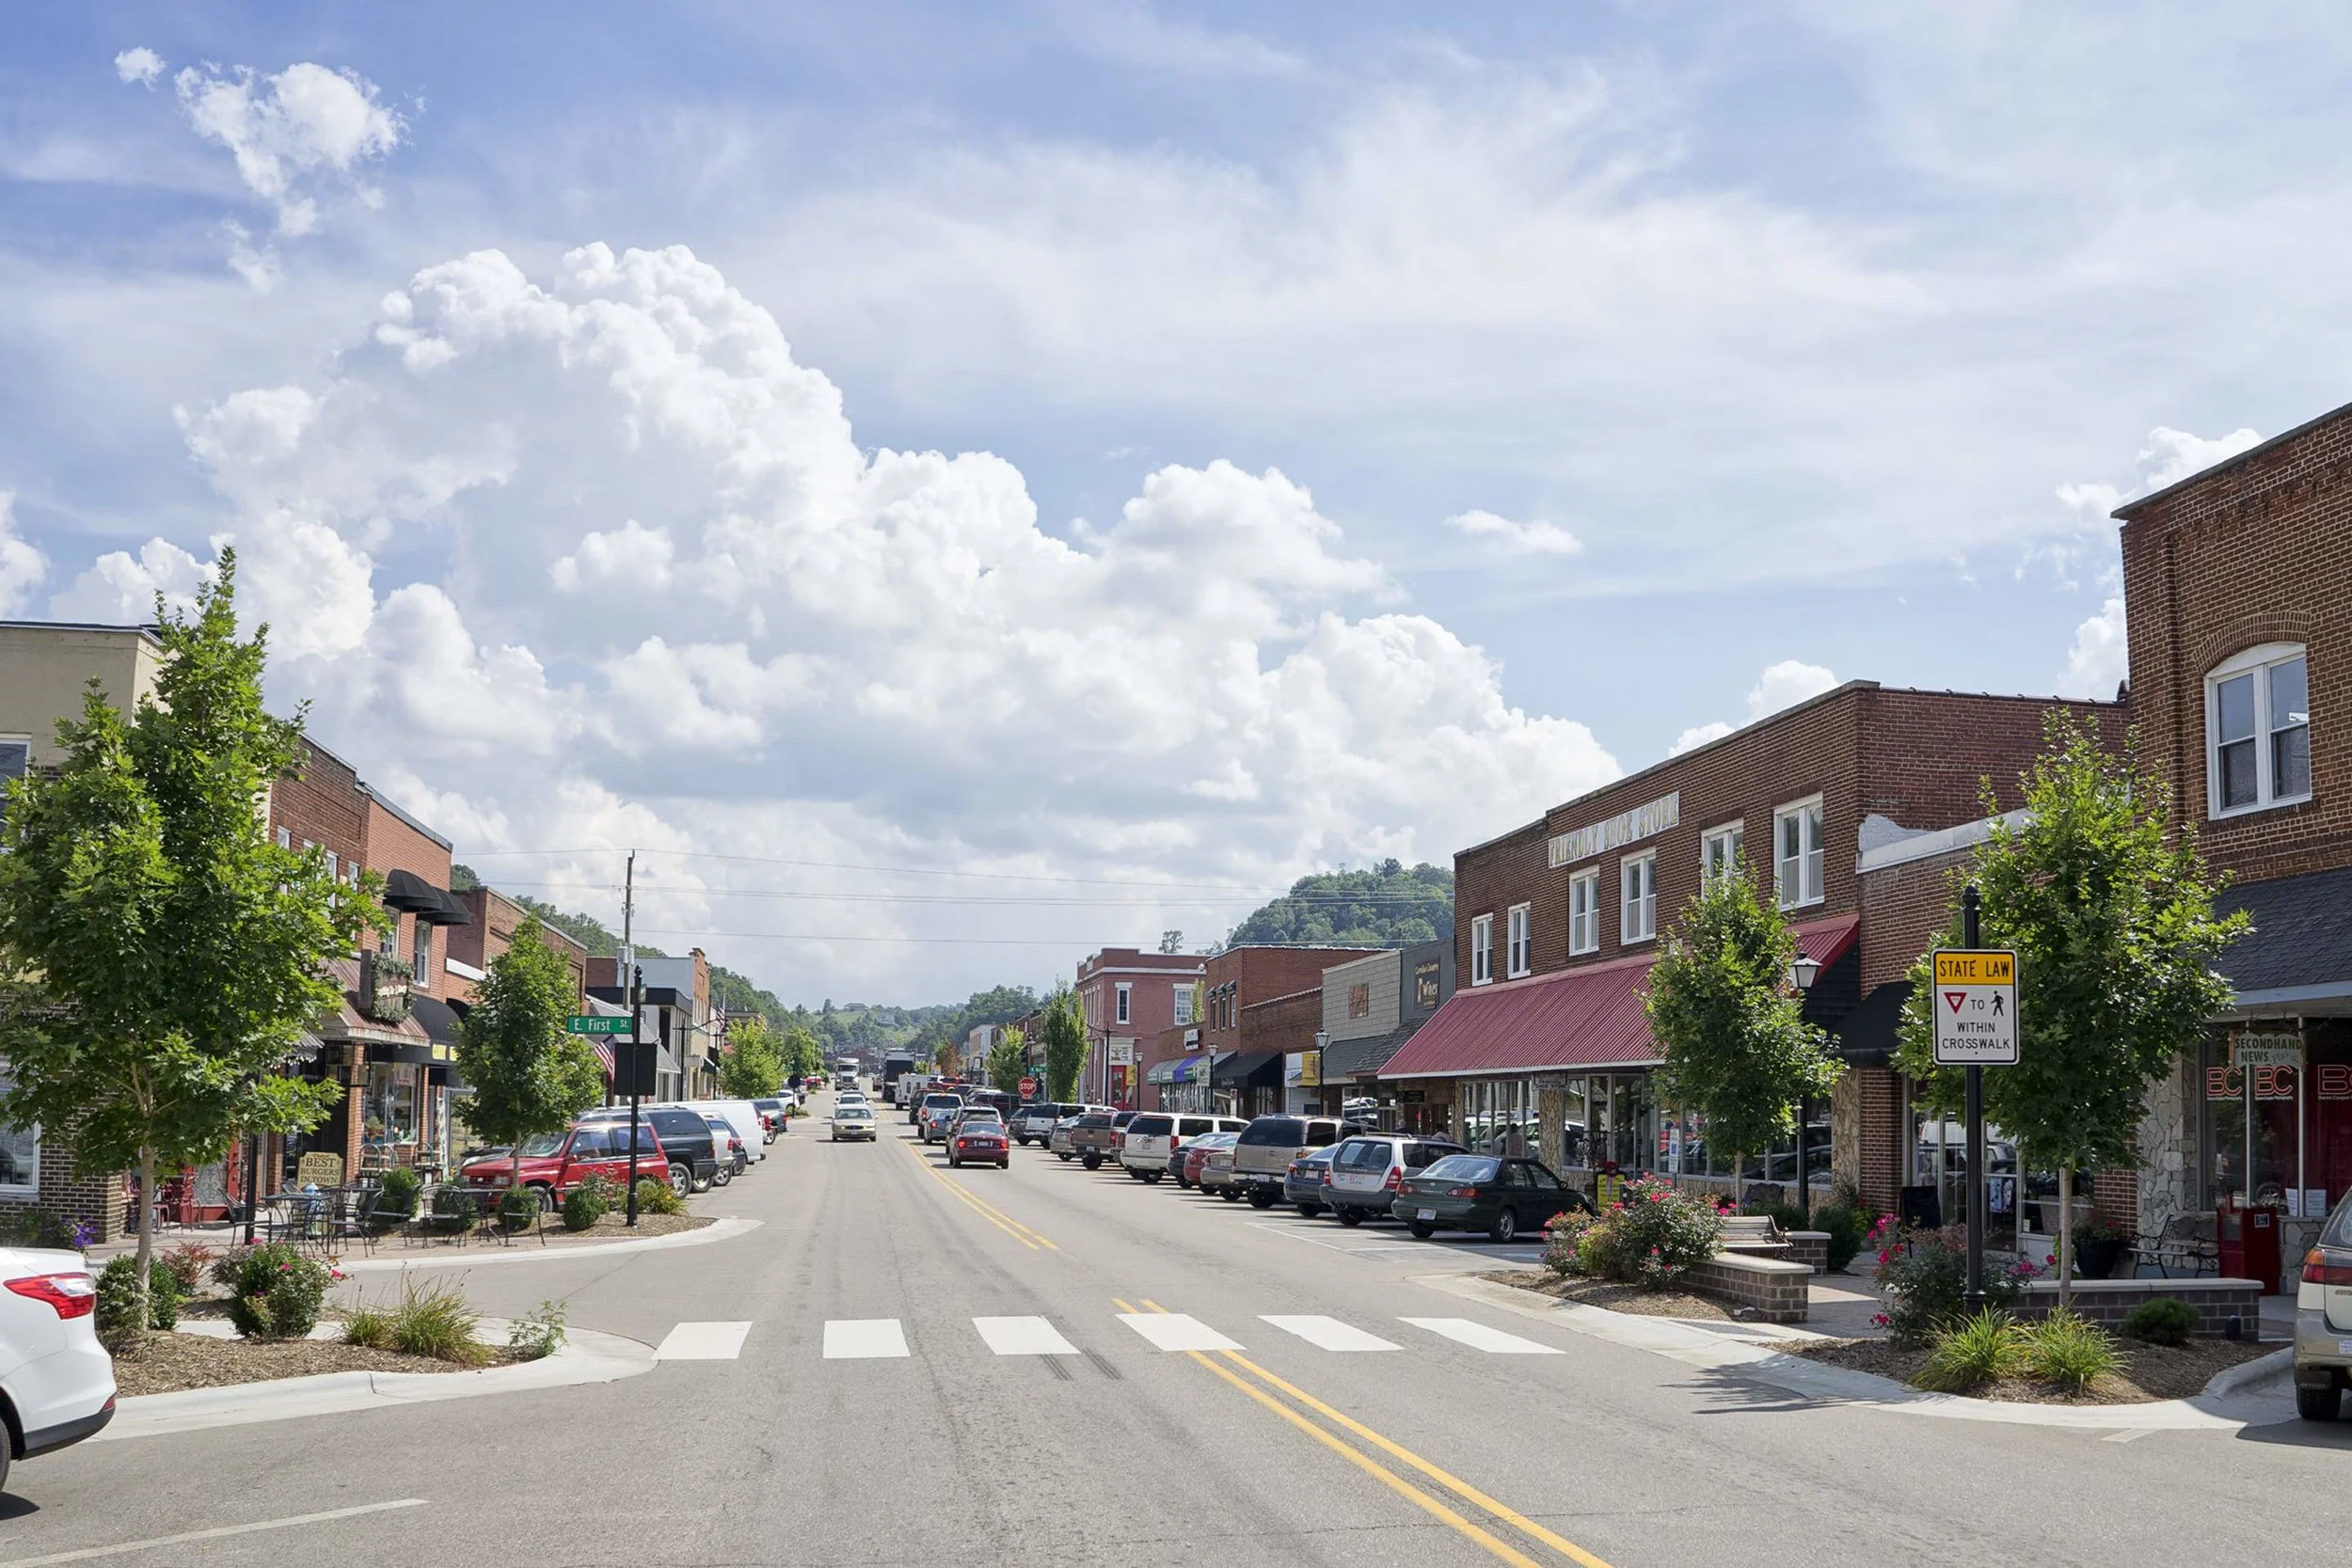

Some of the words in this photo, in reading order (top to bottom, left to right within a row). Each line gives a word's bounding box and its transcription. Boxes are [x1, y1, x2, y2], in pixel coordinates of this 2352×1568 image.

[1549, 824, 1599, 867] FRIENDLY
[1603, 812, 1633, 850] SHOE
[1638, 795, 1678, 838] STORE
[1939, 959, 1977, 977] STATE
[1985, 960, 2010, 977] LAW
[1970, 999, 1985, 1010] TO
[588, 1019, 611, 1031] First
[1956, 1022, 1995, 1033] WITHIN
[1942, 1037, 2010, 1050] CROSSWALK
[2235, 1037, 2302, 1050] SECONDHAND
[2241, 1051, 2269, 1063] NEWS
[2206, 1067, 2243, 1097] BC
[2254, 1064, 2293, 1096] BC
[2317, 1064, 2352, 1095] B
[306, 1158, 337, 1167] BEST
[300, 1167, 340, 1176] BURGERS
